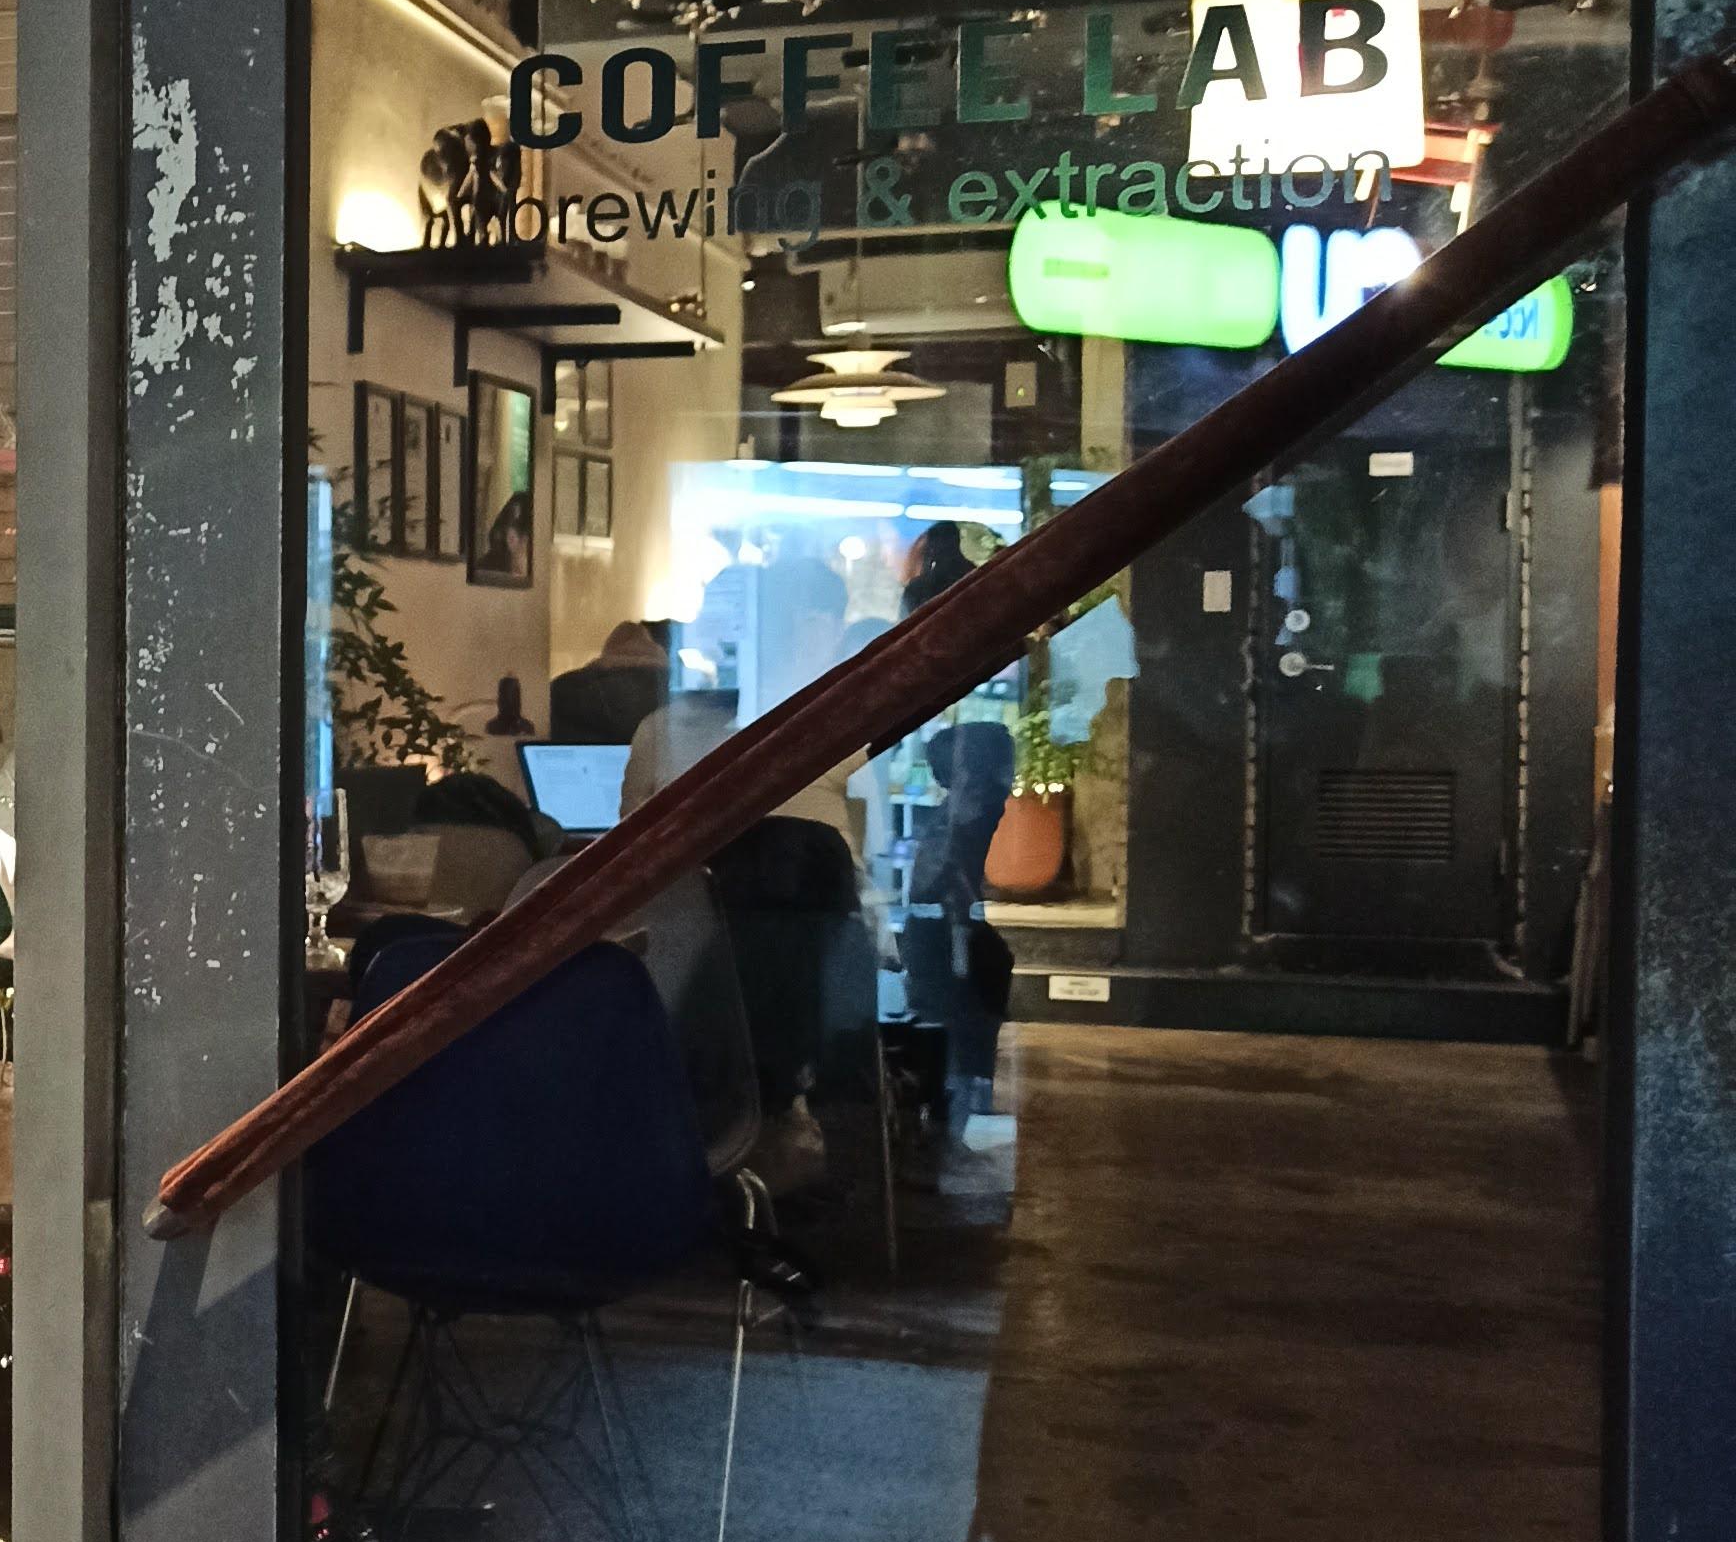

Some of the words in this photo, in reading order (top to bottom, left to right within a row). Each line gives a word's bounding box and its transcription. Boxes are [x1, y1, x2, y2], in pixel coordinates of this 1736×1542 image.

[508, 19, 1033, 150] COFFEE
[507, 170, 823, 253] brewing
[862, 157, 915, 229] &
[947, 138, 1392, 225] extraction
